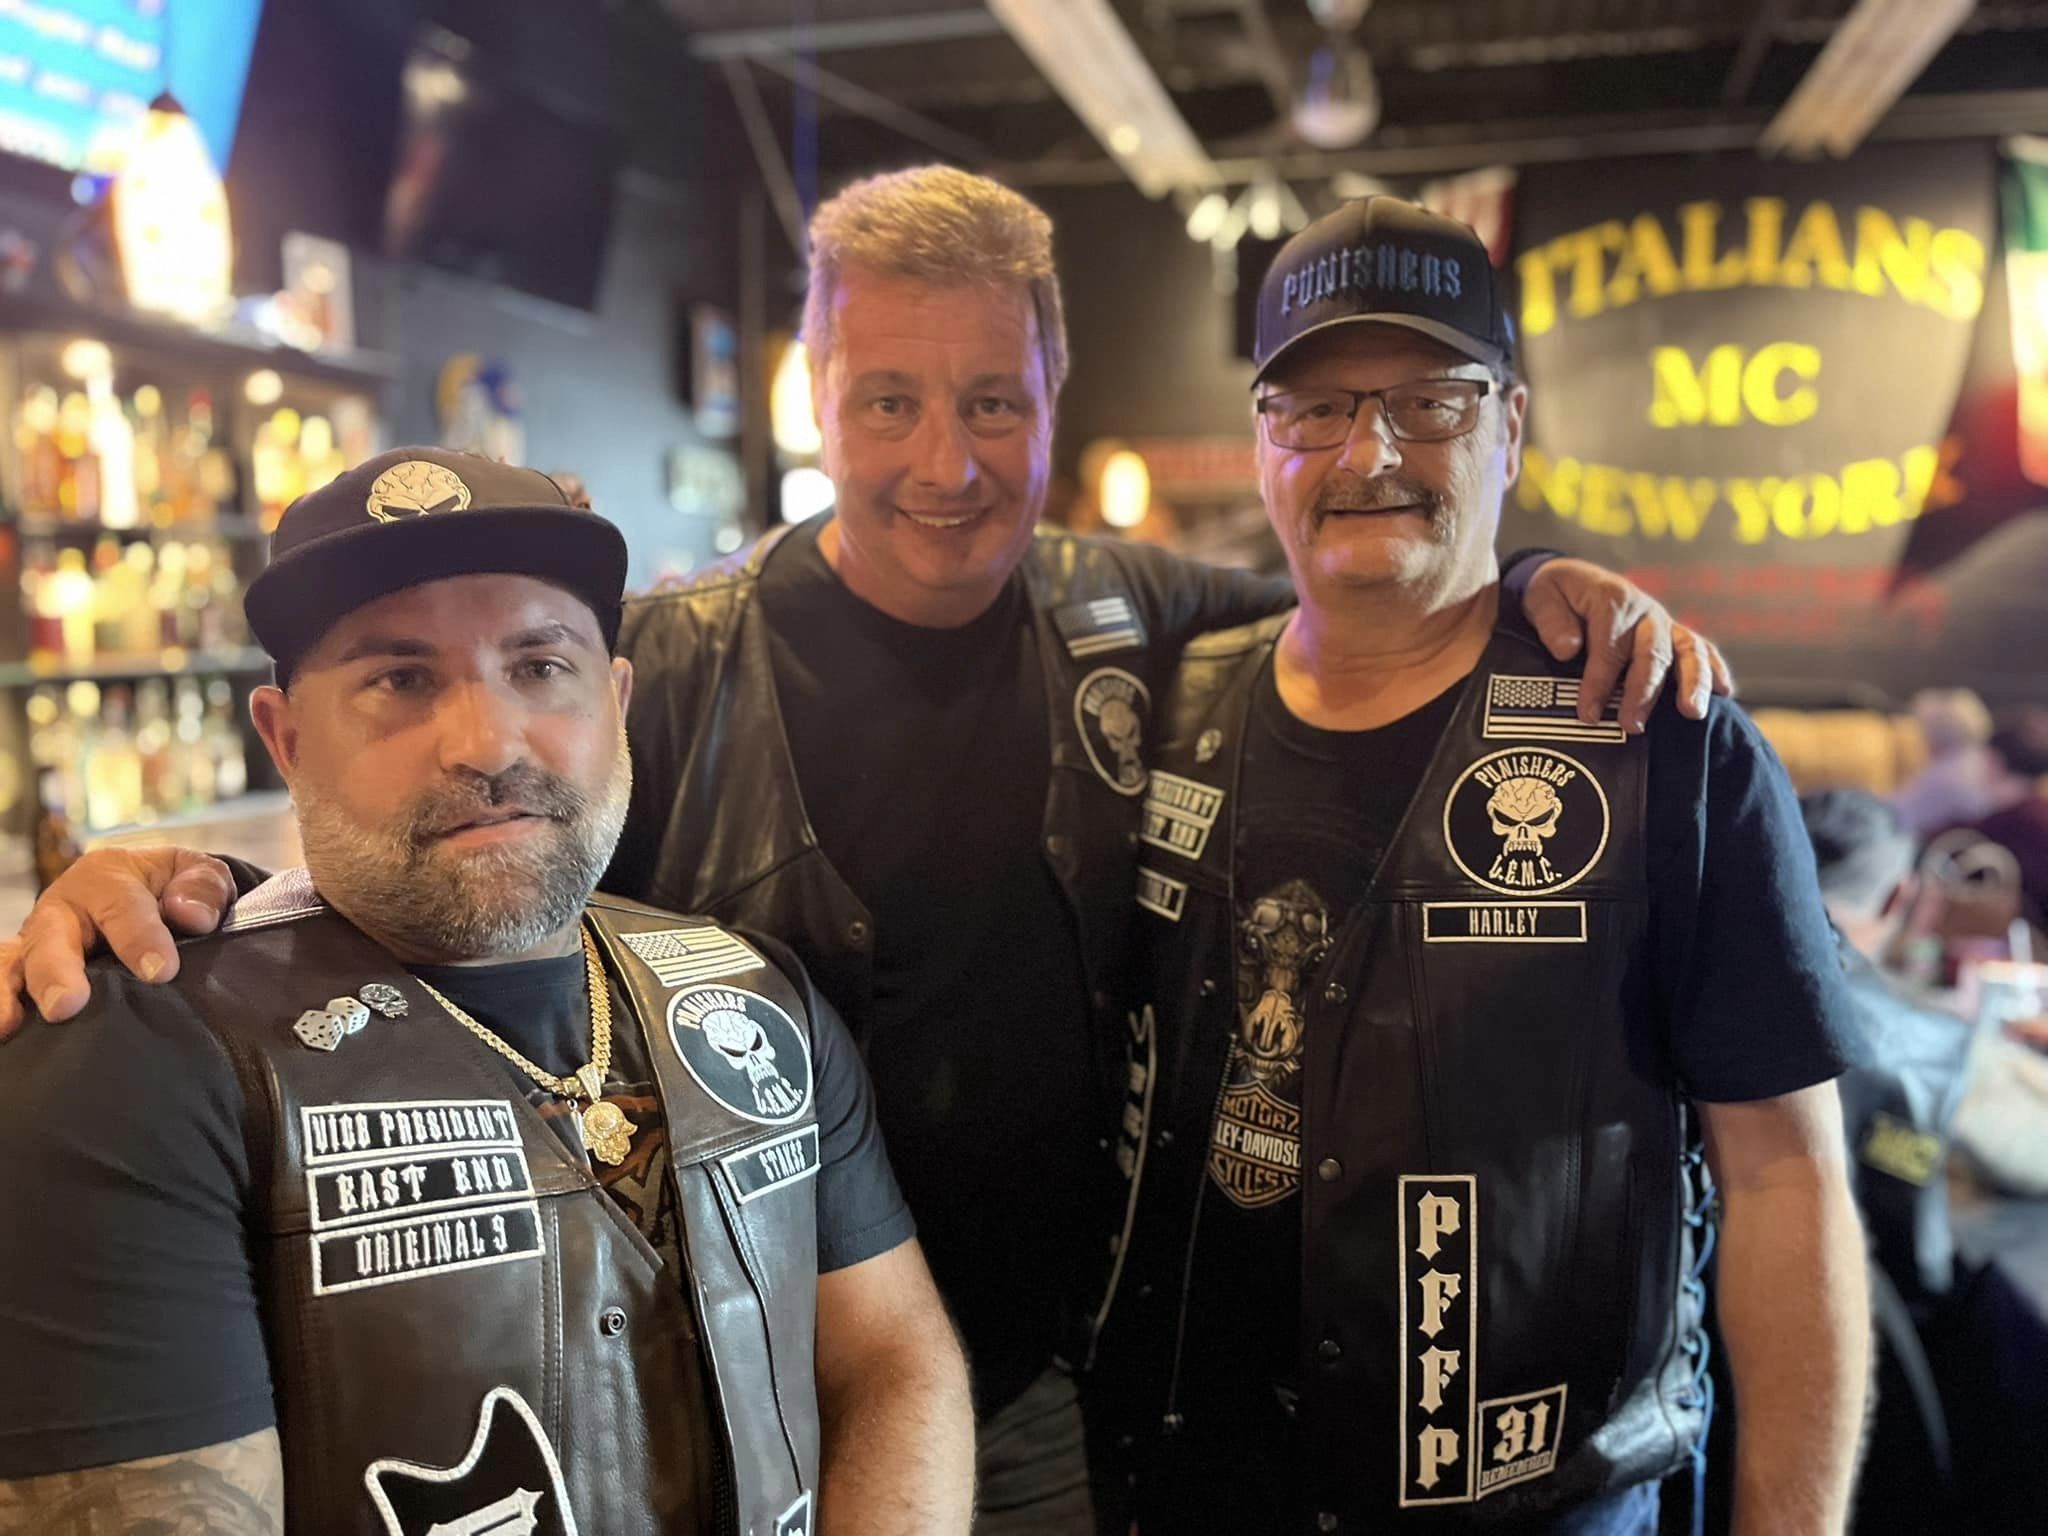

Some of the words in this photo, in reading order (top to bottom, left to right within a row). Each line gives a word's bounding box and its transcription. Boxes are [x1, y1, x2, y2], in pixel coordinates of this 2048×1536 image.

[1281, 243, 1462, 316] PUNISHERS
[1516, 198, 1984, 335] ITALIANS
[1651, 342, 1821, 427] MC
[1518, 445, 1716, 541] NEW
[1726, 438, 1964, 542] YORK
[1474, 756, 1576, 788] PUNISHERS
[1469, 907, 1538, 936] HARLEY
[312, 1111, 371, 1154] VICE
[380, 1106, 511, 1147] PRESIDENT
[1222, 1095, 1286, 1129] MOTOR
[335, 1163, 427, 1214] EAST
[451, 1155, 512, 1194] END
[1213, 1152, 1279, 1195] CYCLES
[355, 1214, 508, 1276] ORIGINALS
[1415, 1190, 1461, 1491] PFFP
[1493, 1400, 1551, 1463] 31
